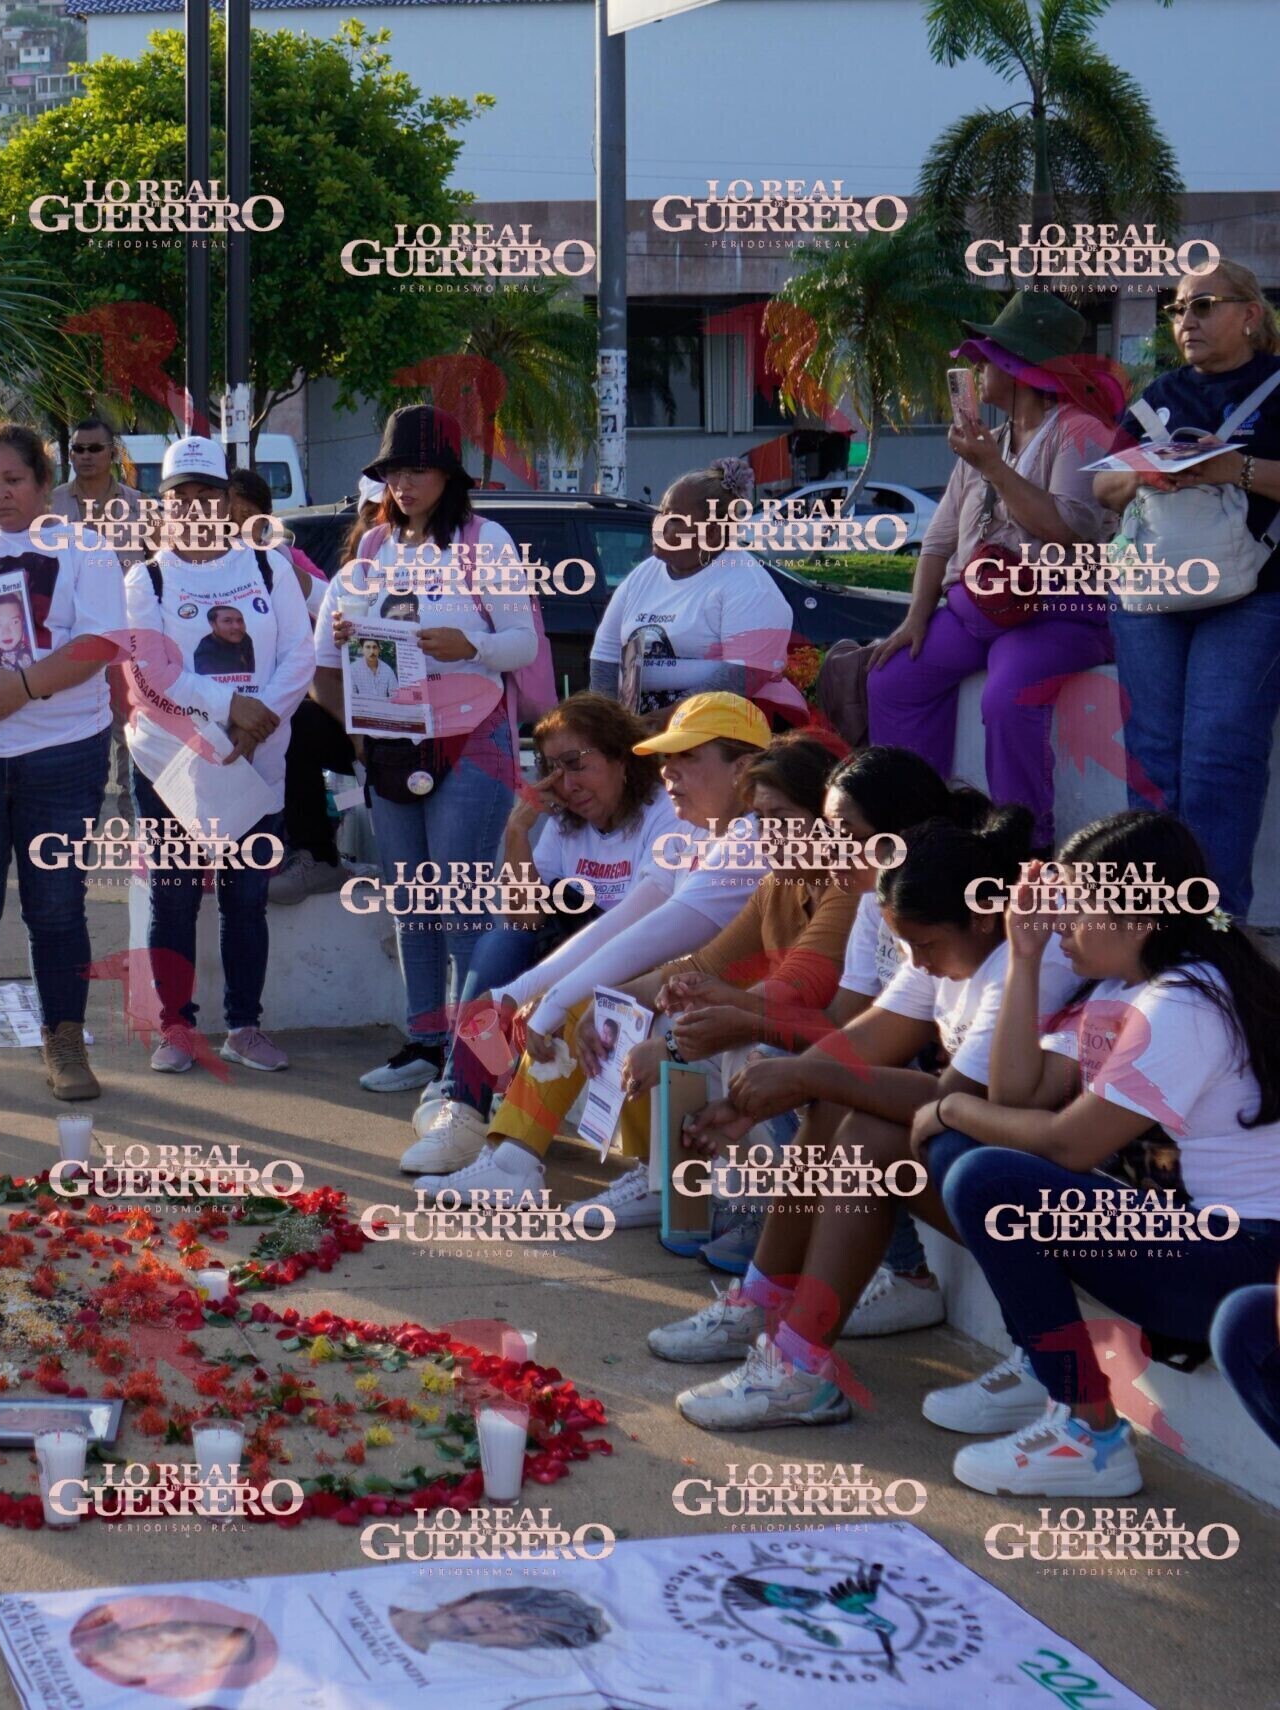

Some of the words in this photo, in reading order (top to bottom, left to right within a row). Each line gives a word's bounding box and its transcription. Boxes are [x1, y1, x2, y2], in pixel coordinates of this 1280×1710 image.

[2, 581, 22, 592] Bernal
[635, 613, 648, 622] SE
[648, 614, 677, 623] BUSCA
